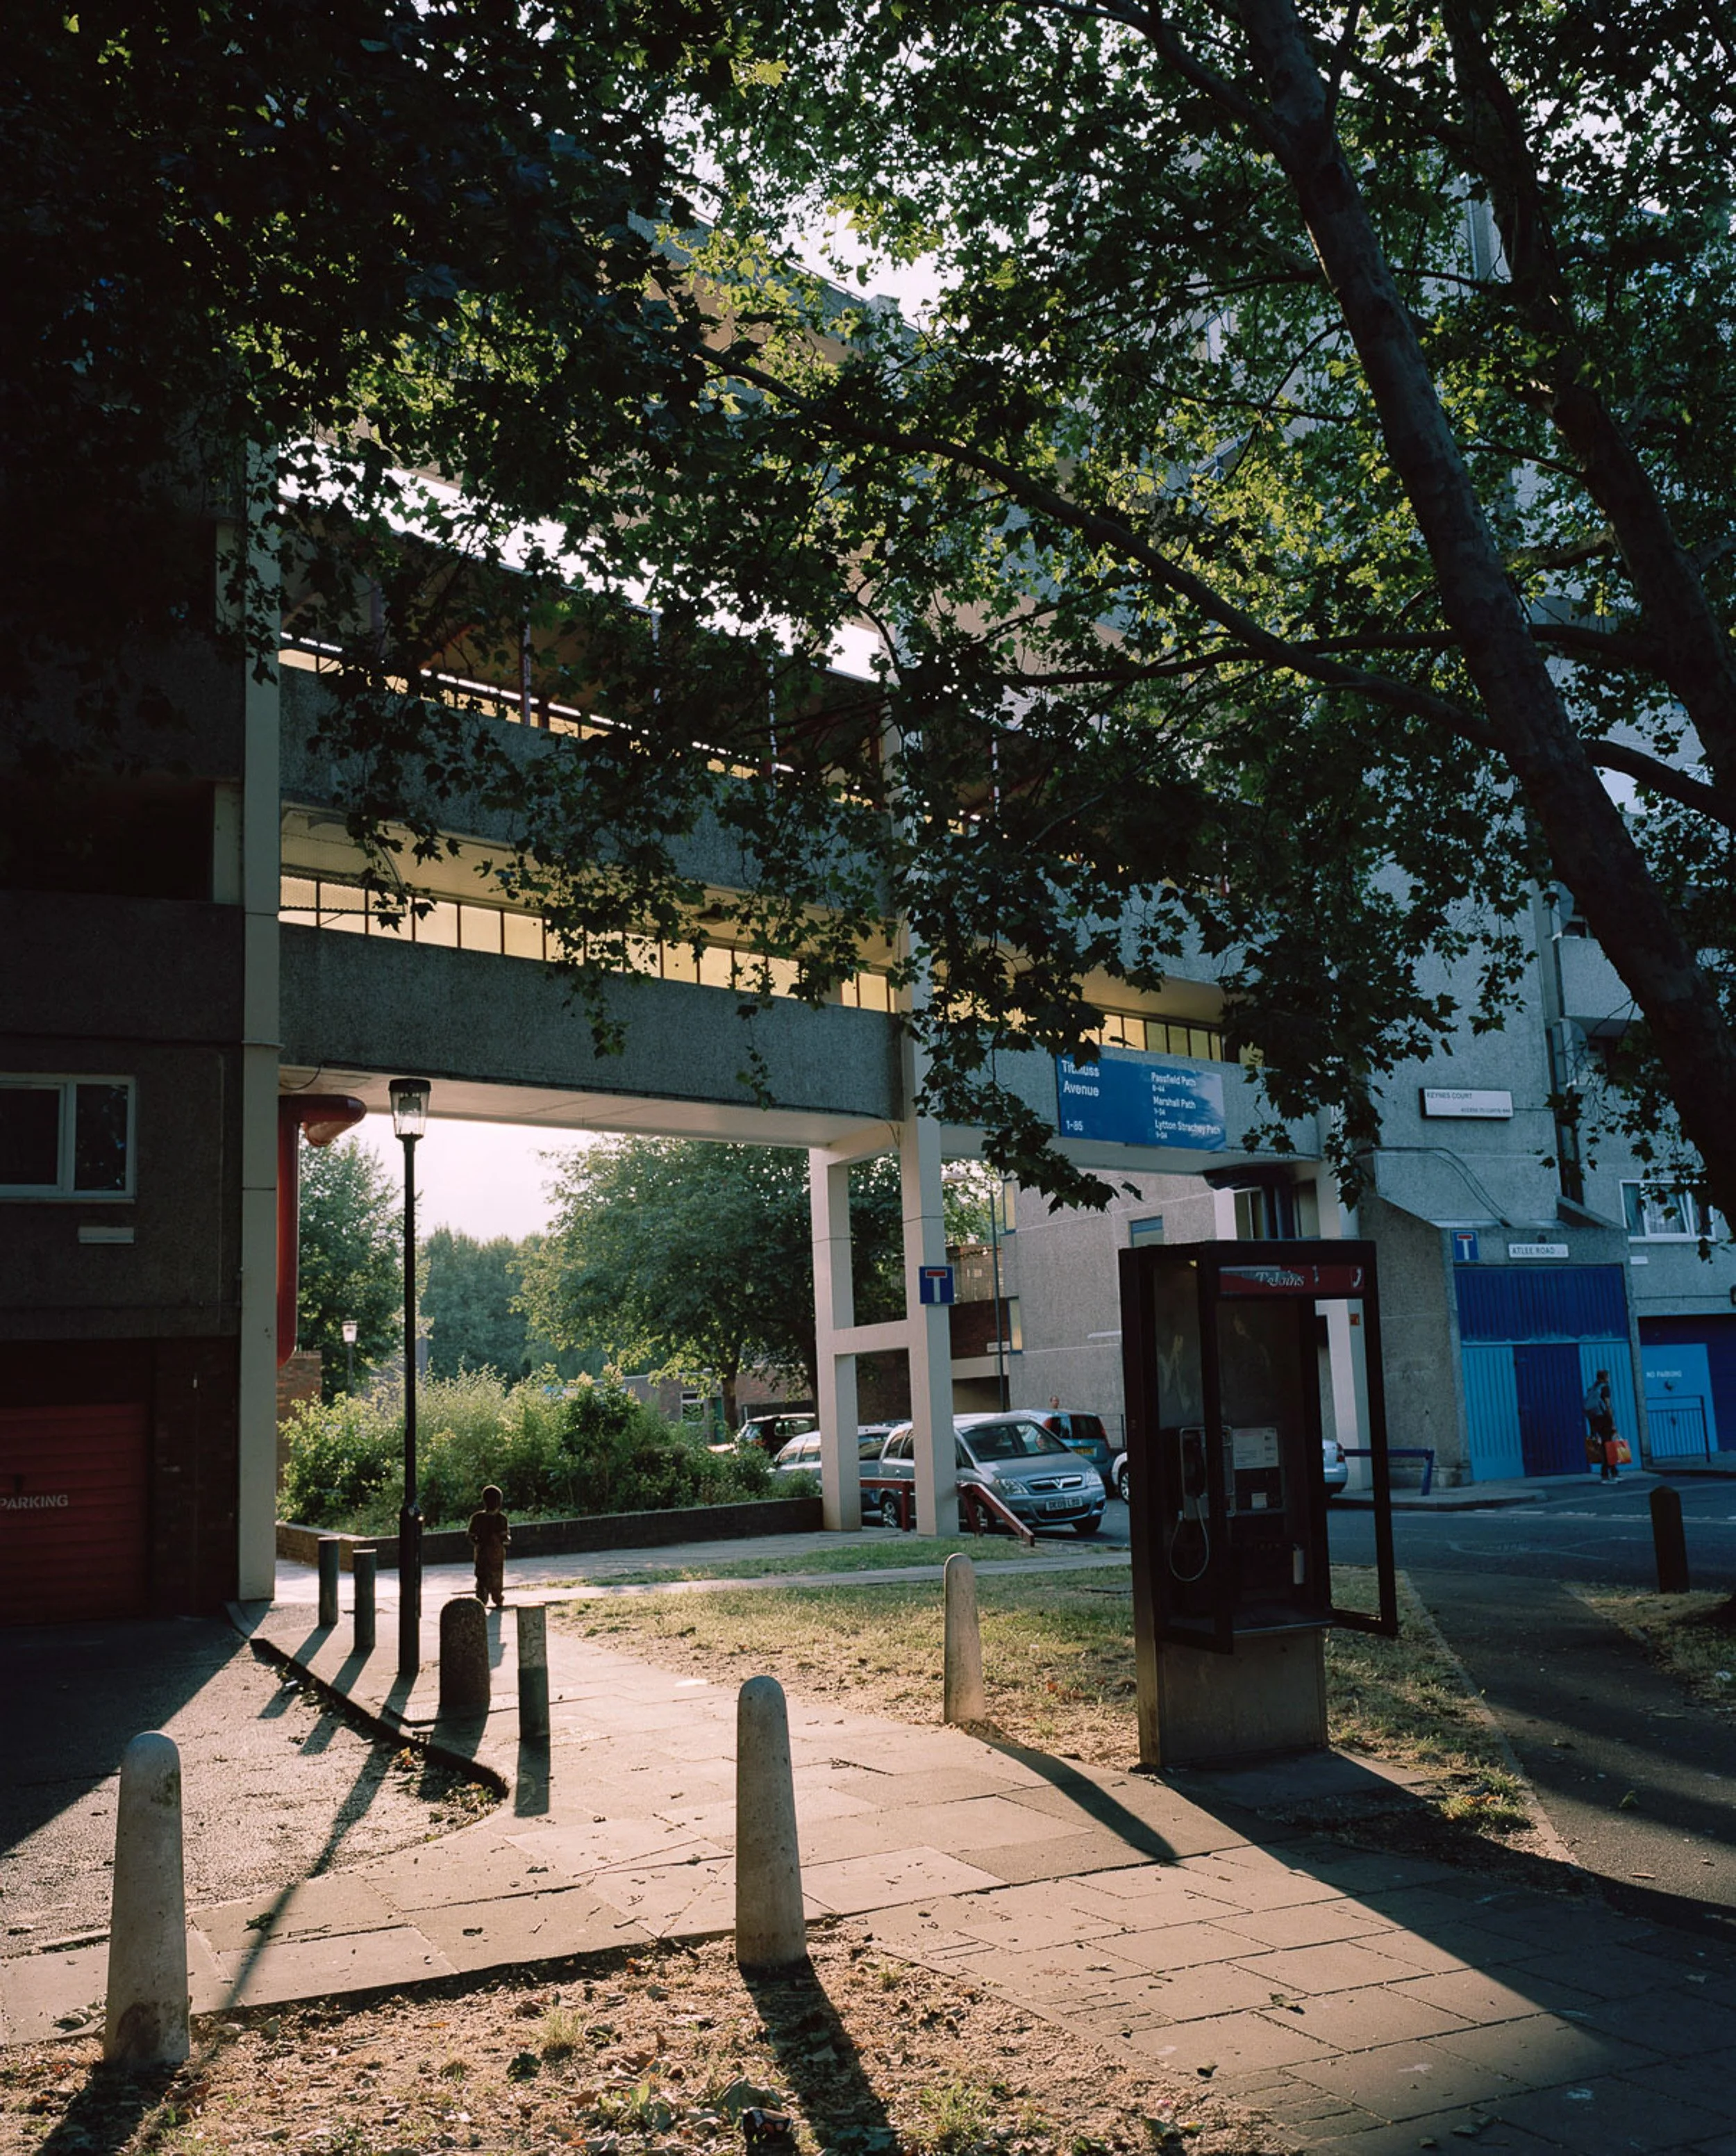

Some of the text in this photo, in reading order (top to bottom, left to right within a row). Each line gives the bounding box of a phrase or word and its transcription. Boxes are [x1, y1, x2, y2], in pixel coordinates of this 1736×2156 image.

[1063, 1080, 1099, 1097] Avenue
[1181, 1076, 1196, 1088] Path
[1153, 1096, 1196, 1109] Marshall Path
[1155, 1120, 1177, 1131] Lytton
[1206, 1125, 1221, 1135] Path
[1535, 1246, 1555, 1254] ROAD
[1657, 1370, 1682, 1378] PARKING
[0, 1494, 69, 1510] PARKING
